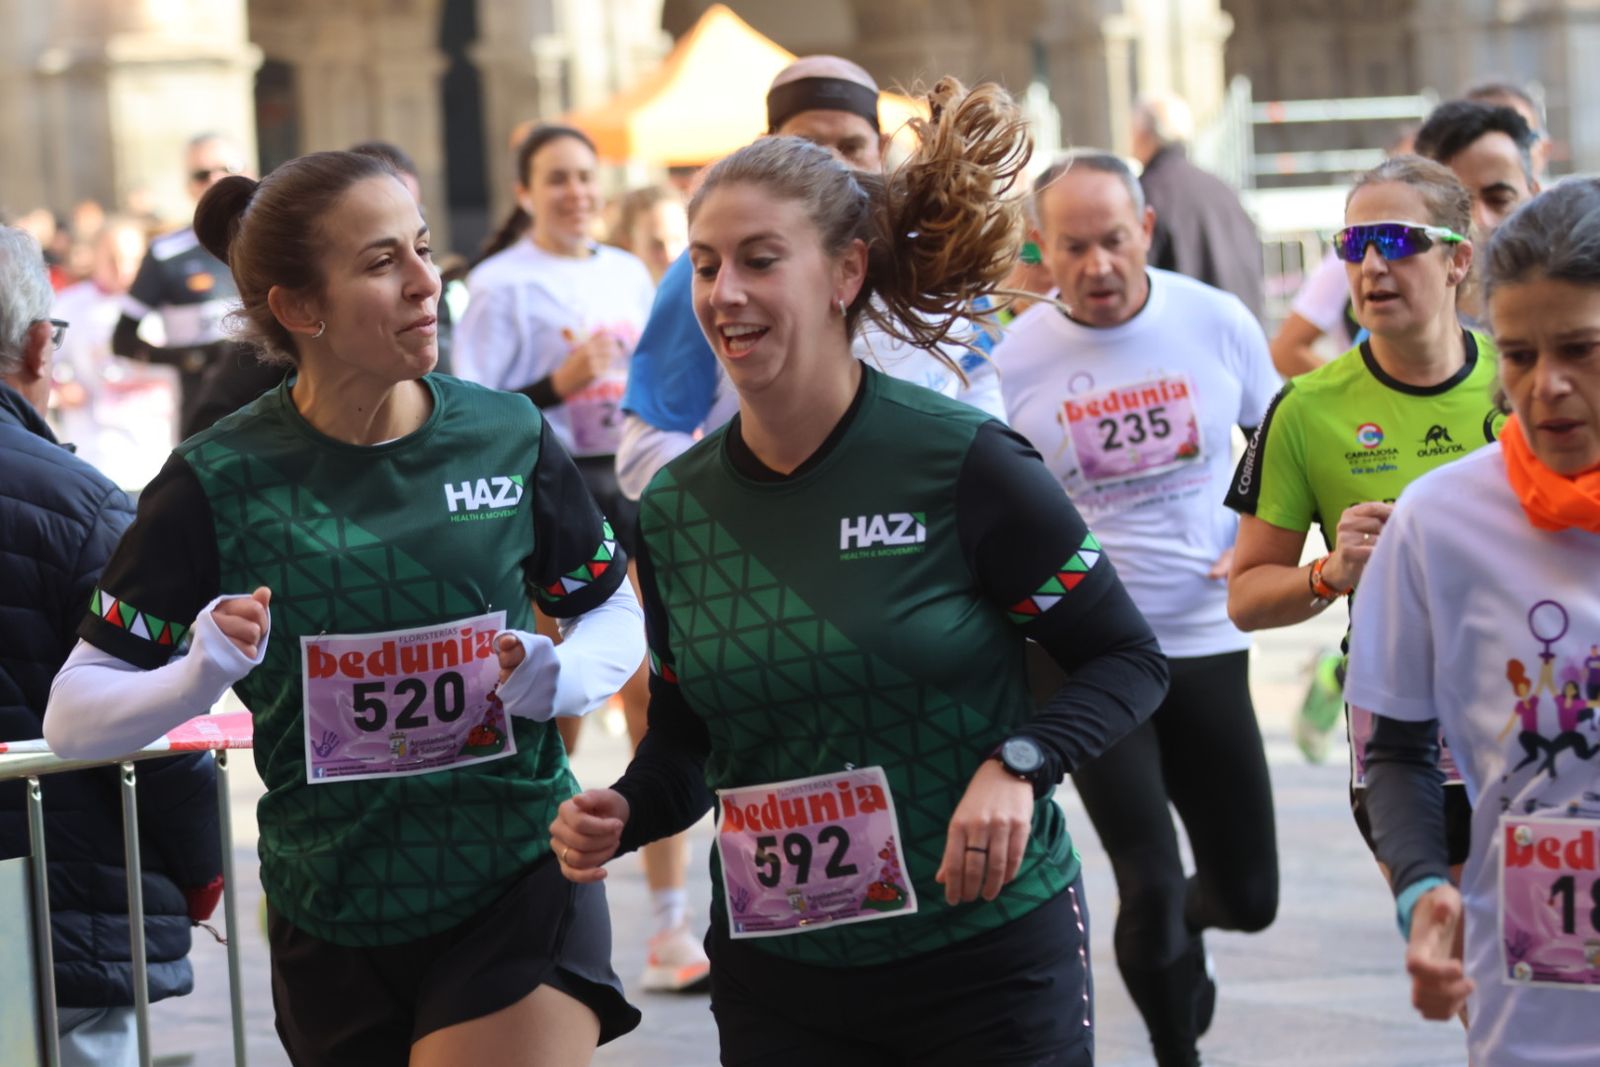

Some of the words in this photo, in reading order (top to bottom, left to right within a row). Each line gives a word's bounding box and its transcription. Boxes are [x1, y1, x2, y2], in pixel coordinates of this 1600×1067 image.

[1064, 380, 1189, 423] bedunia
[1098, 406, 1172, 451] 235
[450, 513, 479, 522] HEALTH
[840, 512, 926, 550] HAZI
[307, 627, 498, 679] bedunia
[398, 627, 458, 645] FLORISTERÍAS
[353, 671, 466, 732] 520
[721, 780, 888, 833] bedunia
[755, 825, 858, 888] 592
[1505, 826, 1600, 871] bed
